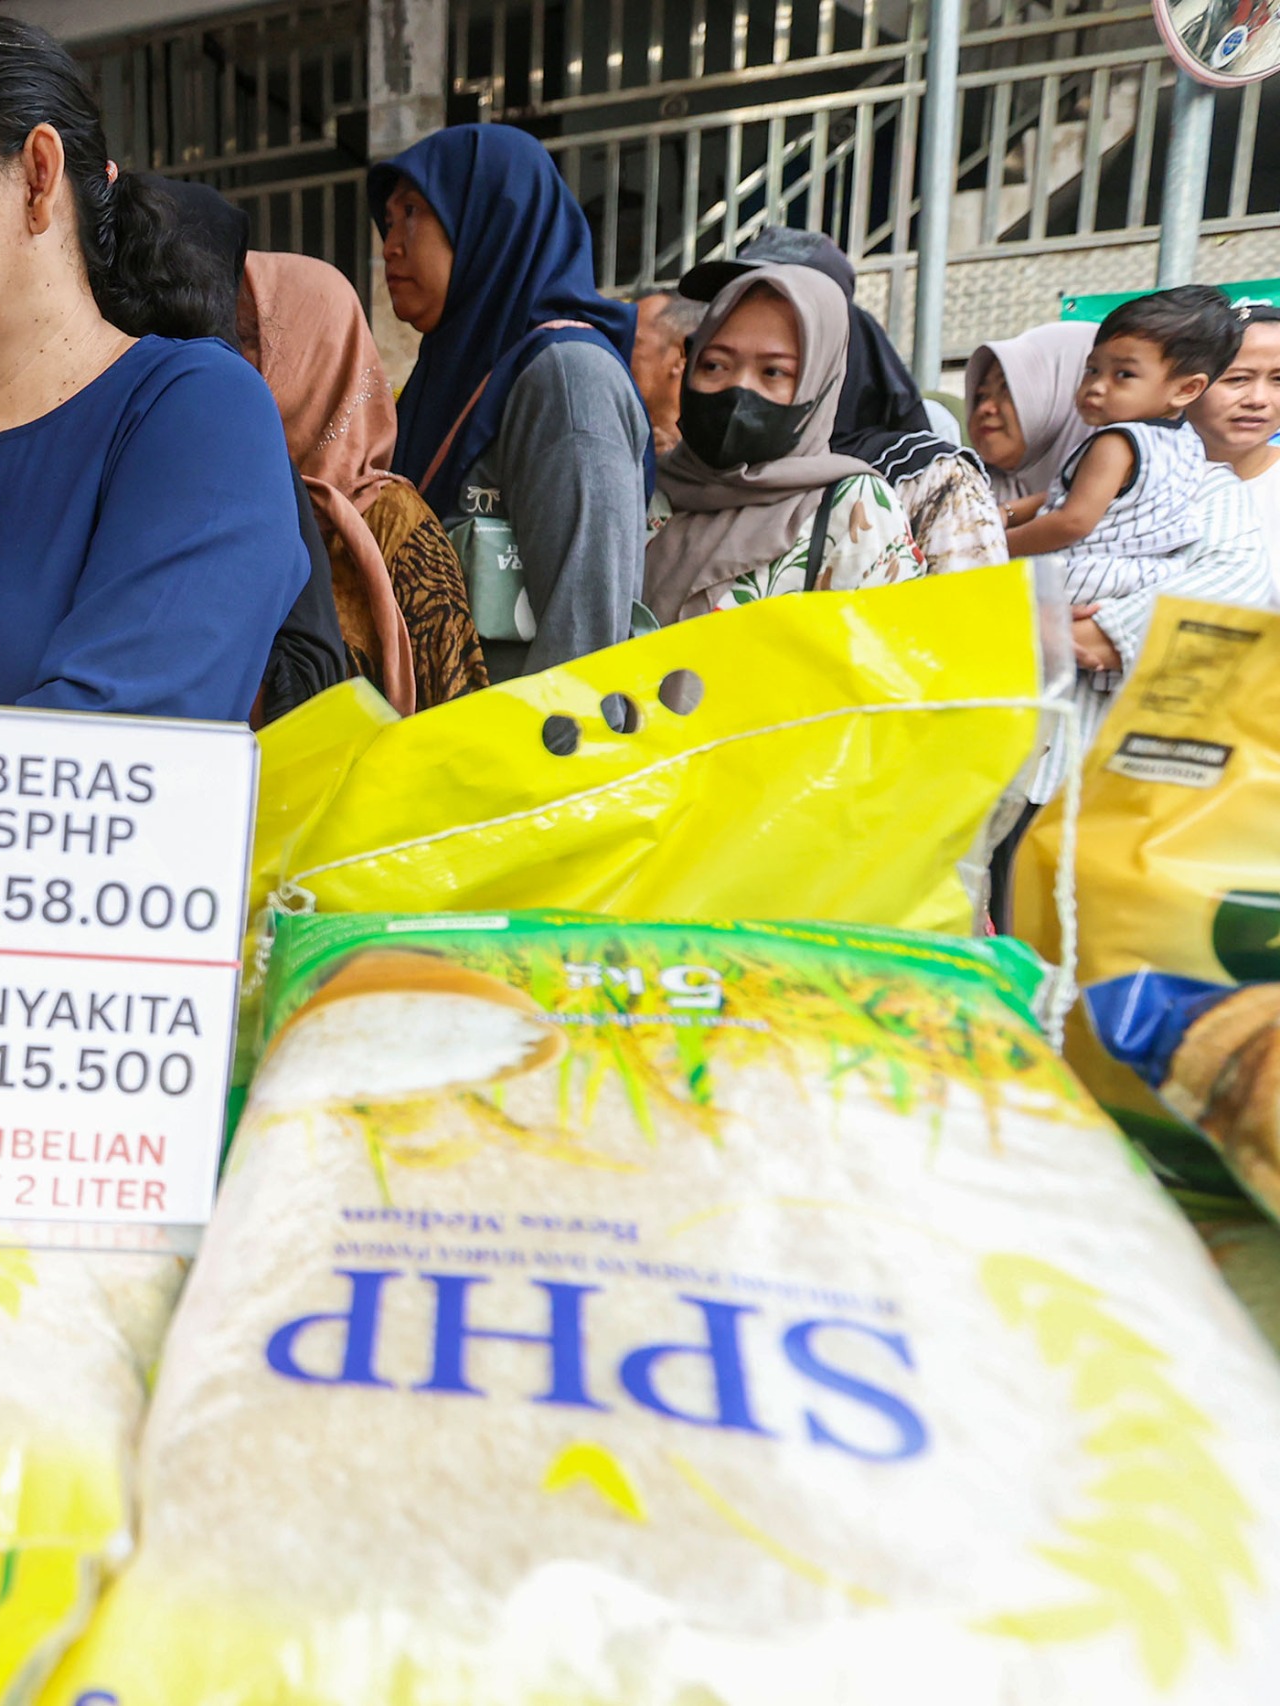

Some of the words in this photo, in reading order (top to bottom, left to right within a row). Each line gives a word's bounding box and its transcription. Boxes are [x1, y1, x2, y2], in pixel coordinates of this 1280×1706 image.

[2, 876, 219, 932] 58.000
[563, 961, 645, 995] kg
[659, 964, 723, 1010] 5
[15, 1175, 36, 1206] 2
[52, 1177, 167, 1211] LITER
[265, 1267, 930, 1463] SPHP
